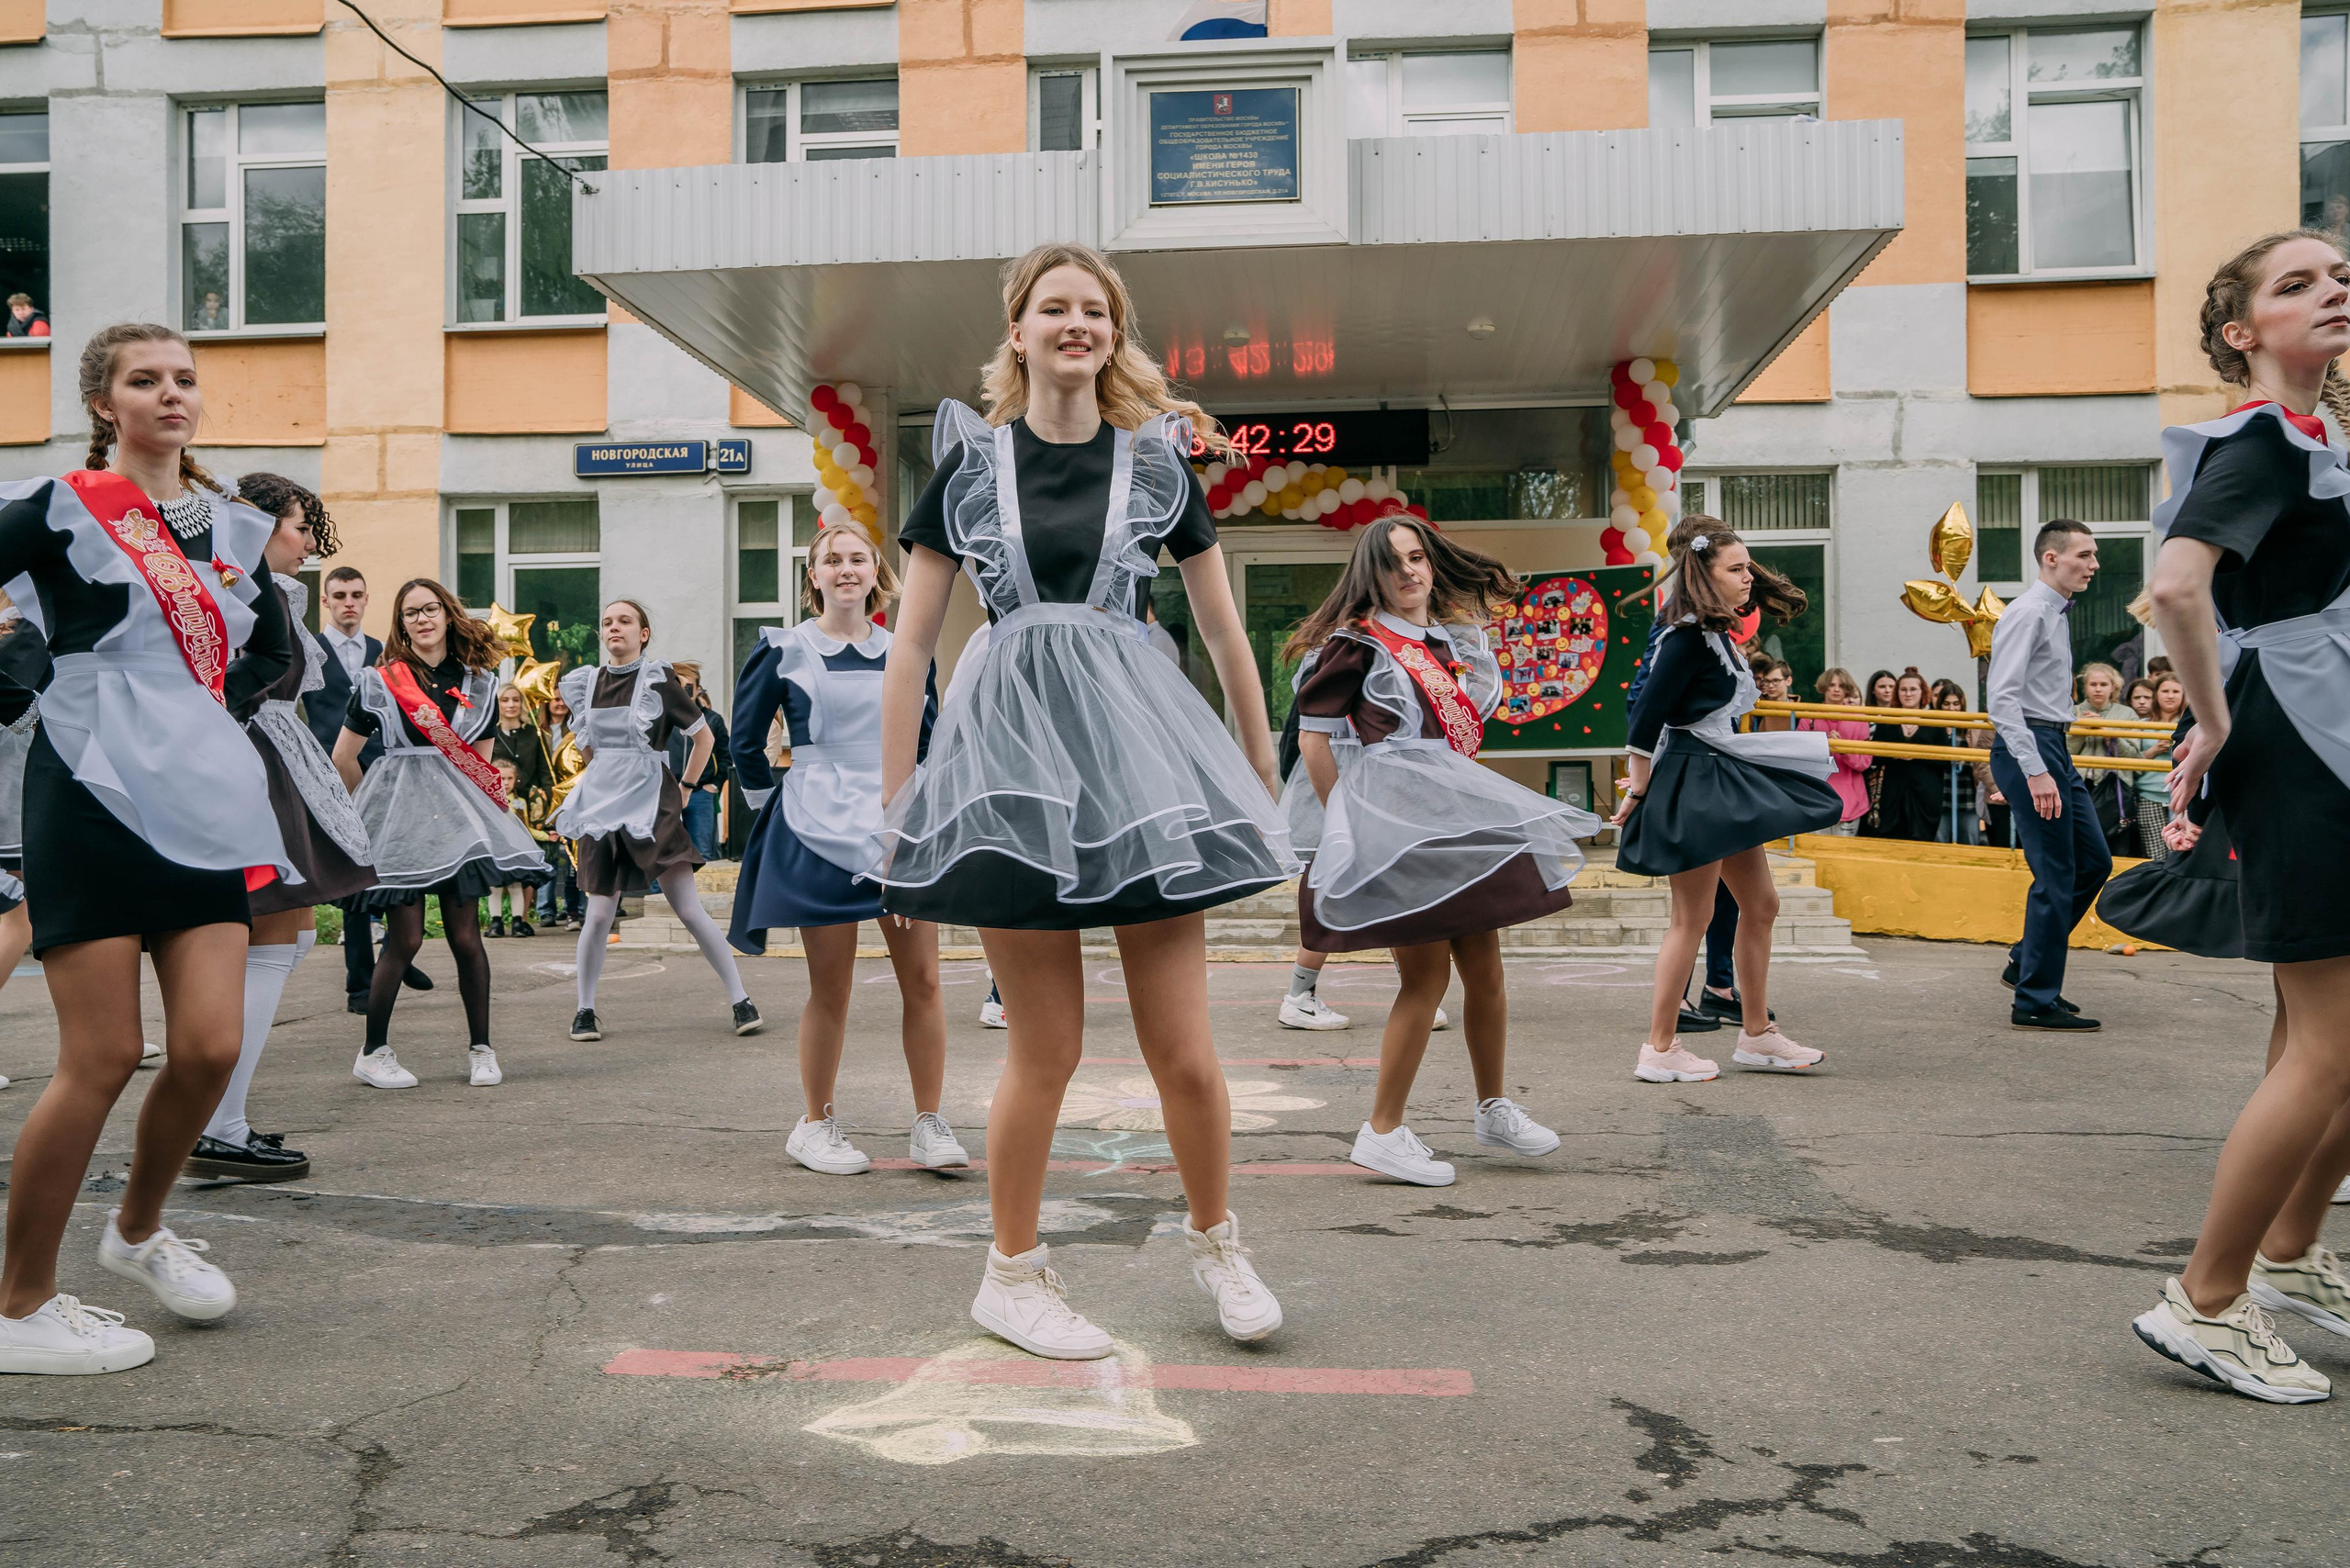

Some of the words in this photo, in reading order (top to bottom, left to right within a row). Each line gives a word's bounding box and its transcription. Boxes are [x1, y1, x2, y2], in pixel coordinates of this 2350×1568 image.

[1158, 137, 1244, 145] ОБЩЕОБРАЗОВАТЕЛЬНОЕ
[1190, 152, 1227, 161] «ШКОЛА
[1229, 151, 1259, 160] №1430
[1192, 162, 1224, 170] ИМЕНИ
[1157, 170, 1261, 180] СОЦИАЛИСТИЧЕСКОГО
[1262, 168, 1292, 177] ТРУДА
[591, 447, 688, 461] НОВГОРОДСКАЯ
[720, 448, 744, 463] 21А
